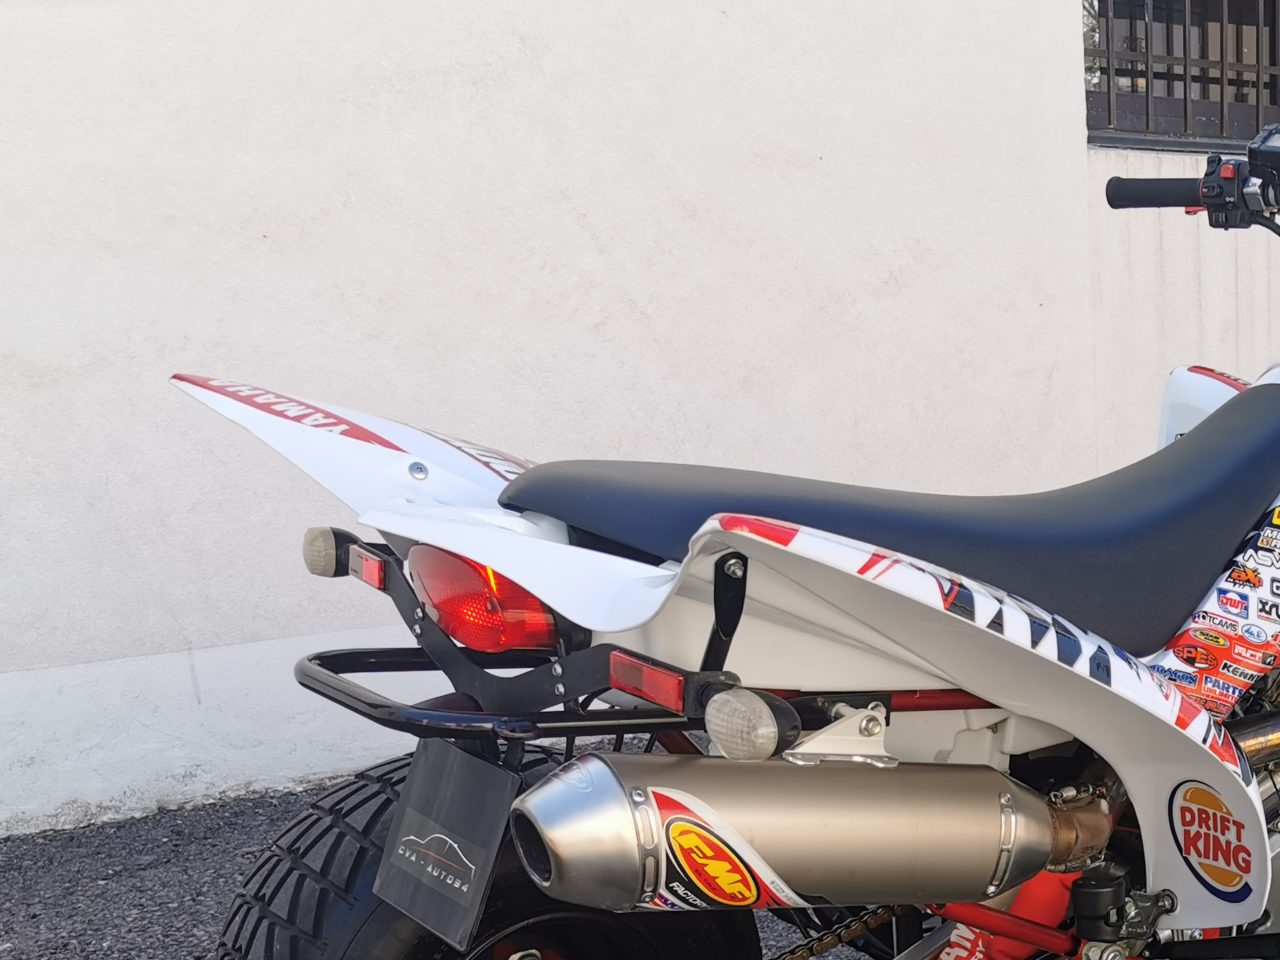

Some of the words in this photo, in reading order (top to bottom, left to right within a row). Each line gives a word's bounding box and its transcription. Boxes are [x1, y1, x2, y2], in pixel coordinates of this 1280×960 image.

[207, 378, 350, 434] YAMAHA
[1220, 595, 1248, 611] DWT
[1174, 646, 1217, 665] SPES
[1204, 675, 1244, 698] PARTS
[1180, 805, 1245, 843] DRIFT
[397, 845, 417, 862] CVA
[672, 832, 755, 900] FMF
[1183, 828, 1252, 875] KING
